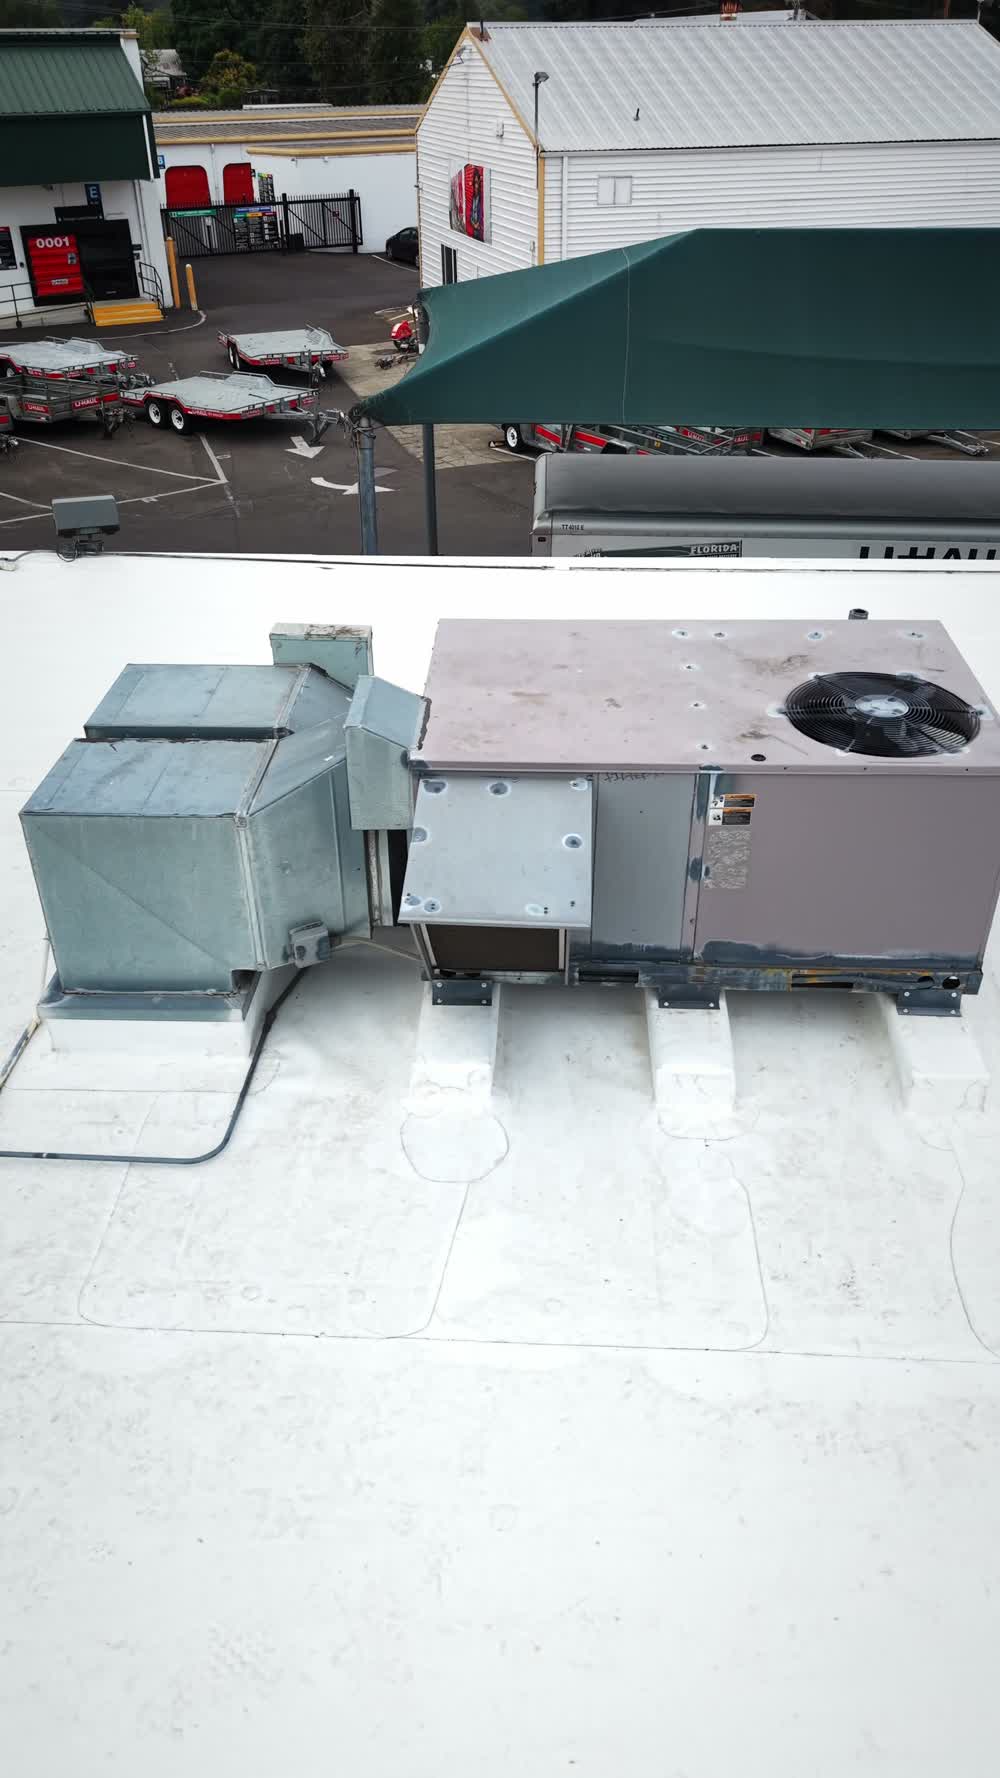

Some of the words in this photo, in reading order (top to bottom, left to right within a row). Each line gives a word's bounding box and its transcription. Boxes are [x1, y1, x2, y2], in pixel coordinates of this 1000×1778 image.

[89, 186, 98, 198] E
[36, 237, 70, 248] 0001
[73, 398, 98, 407] U-HAUL
[690, 544, 737, 555] FLORIDA
